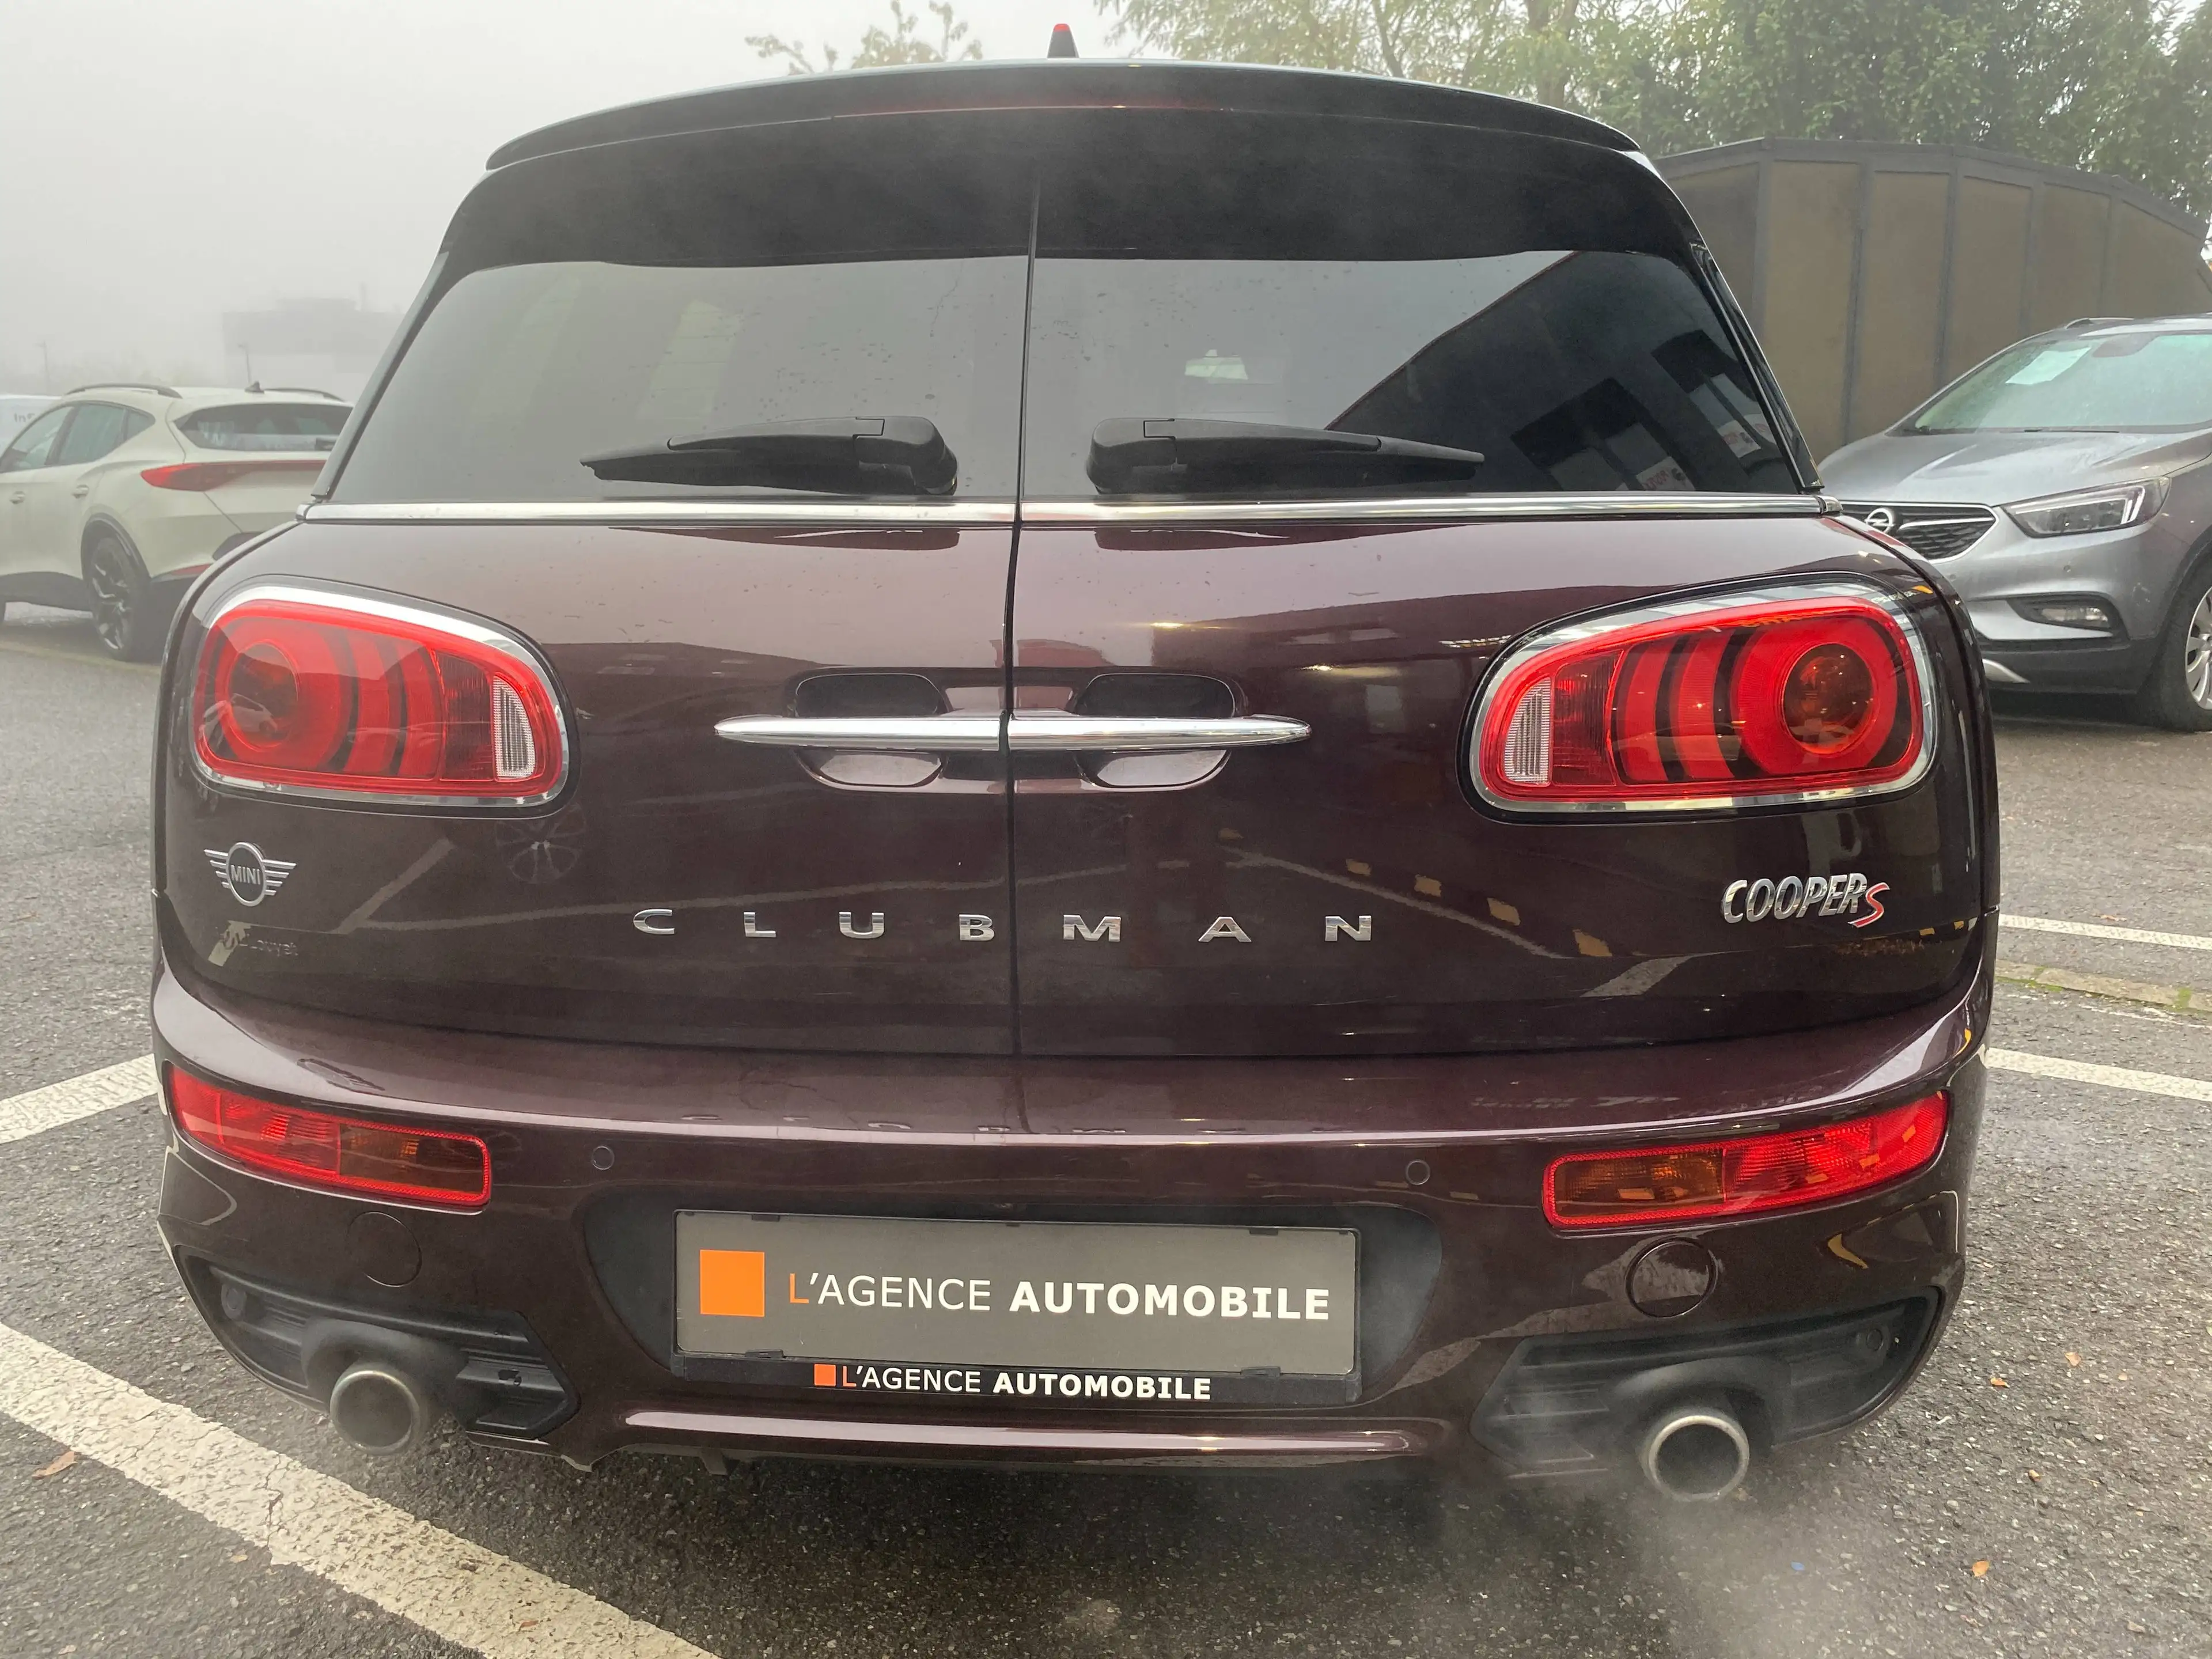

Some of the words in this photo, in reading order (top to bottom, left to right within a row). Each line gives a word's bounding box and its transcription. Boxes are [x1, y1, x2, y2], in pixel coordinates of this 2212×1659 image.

[230, 865, 260, 885] MINI
[790, 1272, 991, 1310] L'AGENCE
[1009, 1281, 1329, 1320] AUTOMOBILE
[842, 1366, 980, 1392] L'AGENCE
[993, 1372, 1210, 1399] AUTOMOBILE
